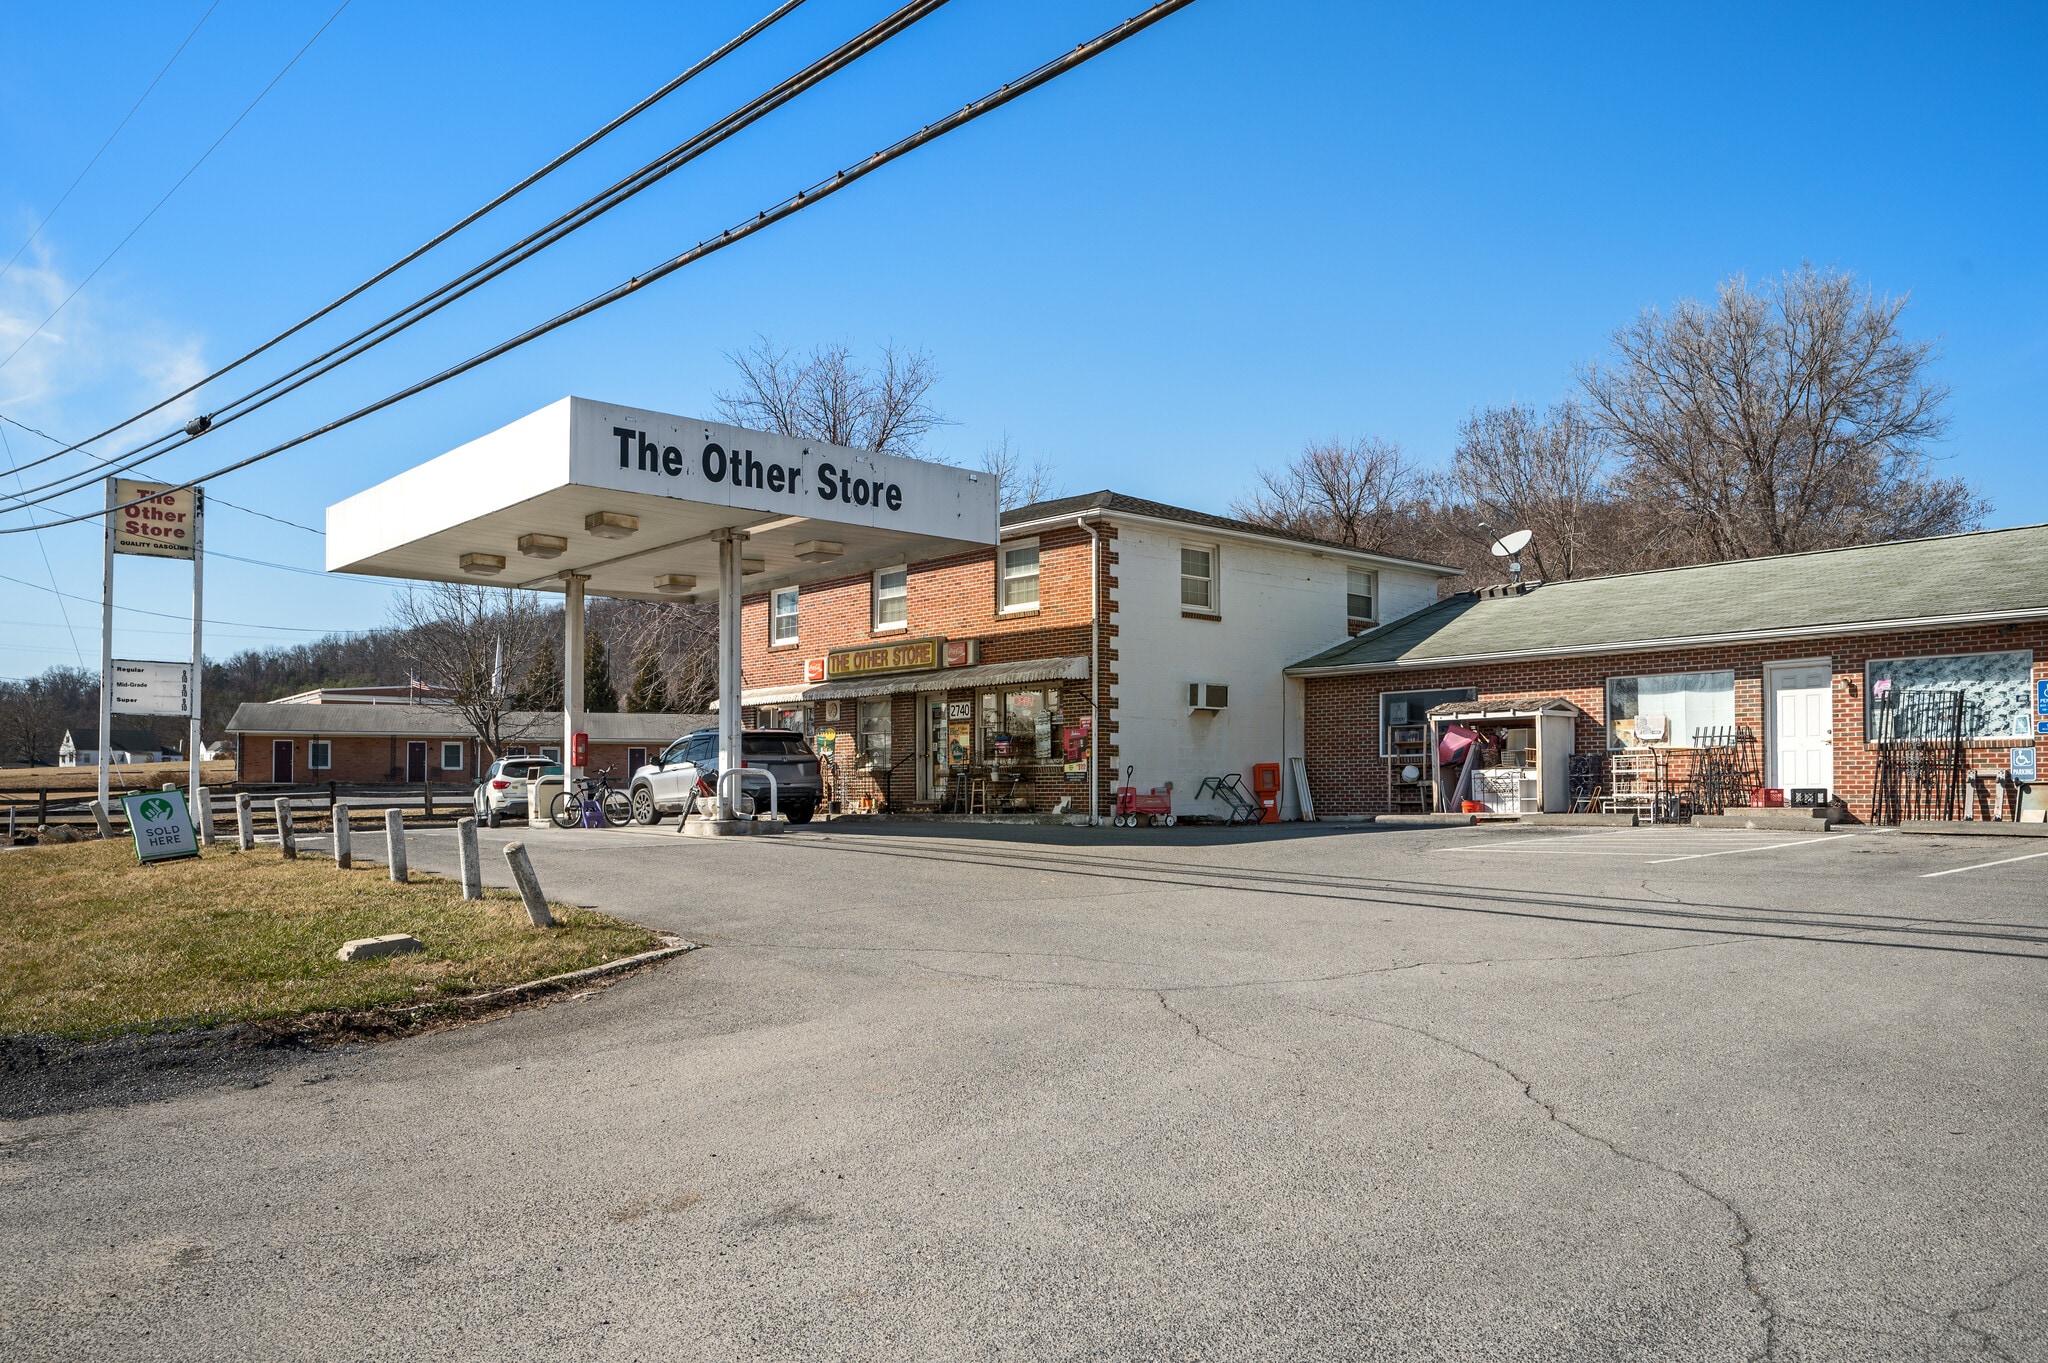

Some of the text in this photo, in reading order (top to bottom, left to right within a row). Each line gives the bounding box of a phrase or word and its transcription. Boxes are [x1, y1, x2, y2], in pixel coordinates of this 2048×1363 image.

[613, 426, 902, 512] The Other Store
[137, 489, 175, 505] The
[125, 505, 186, 522] Other
[126, 521, 185, 538] Store
[120, 540, 189, 551] QUALITY GASOLINE
[830, 643, 931, 672] THE OTHER STORE
[1012, 695, 1035, 707] OPEN
[950, 704, 970, 717] 2740
[146, 826, 180, 836] SOLD
[150, 835, 181, 846] HERE
